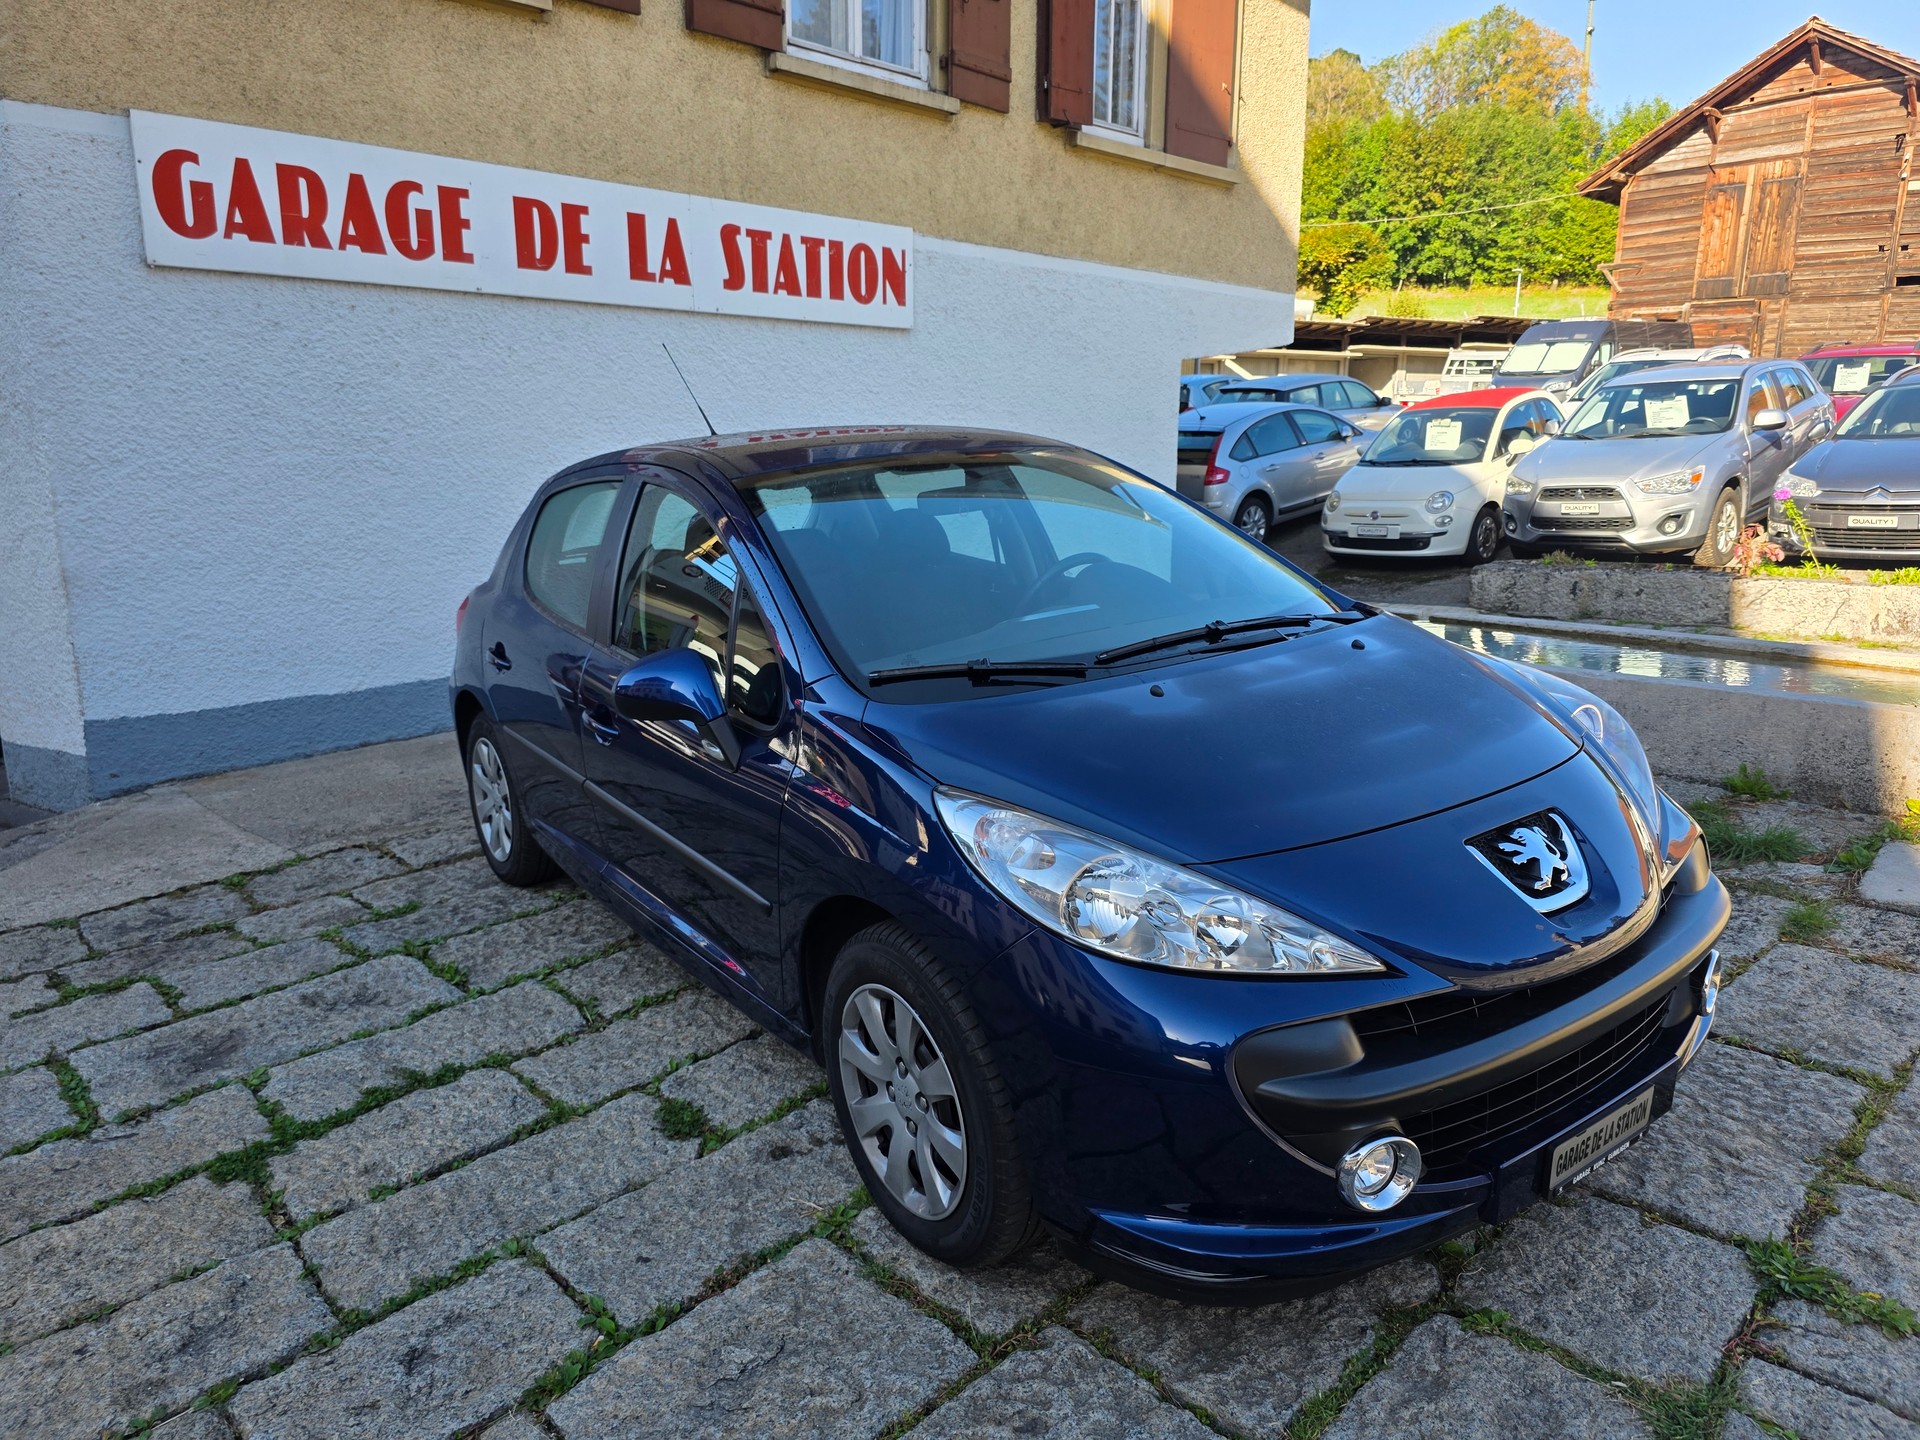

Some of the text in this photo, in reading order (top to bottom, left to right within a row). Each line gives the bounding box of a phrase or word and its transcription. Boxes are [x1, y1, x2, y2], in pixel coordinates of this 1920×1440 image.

[152, 149, 906, 306] GARAGE DE LA STATION
[1555, 1098, 1649, 1177] GARAGE DE LA STATION
[1573, 1167, 1592, 1184] GARAGE
